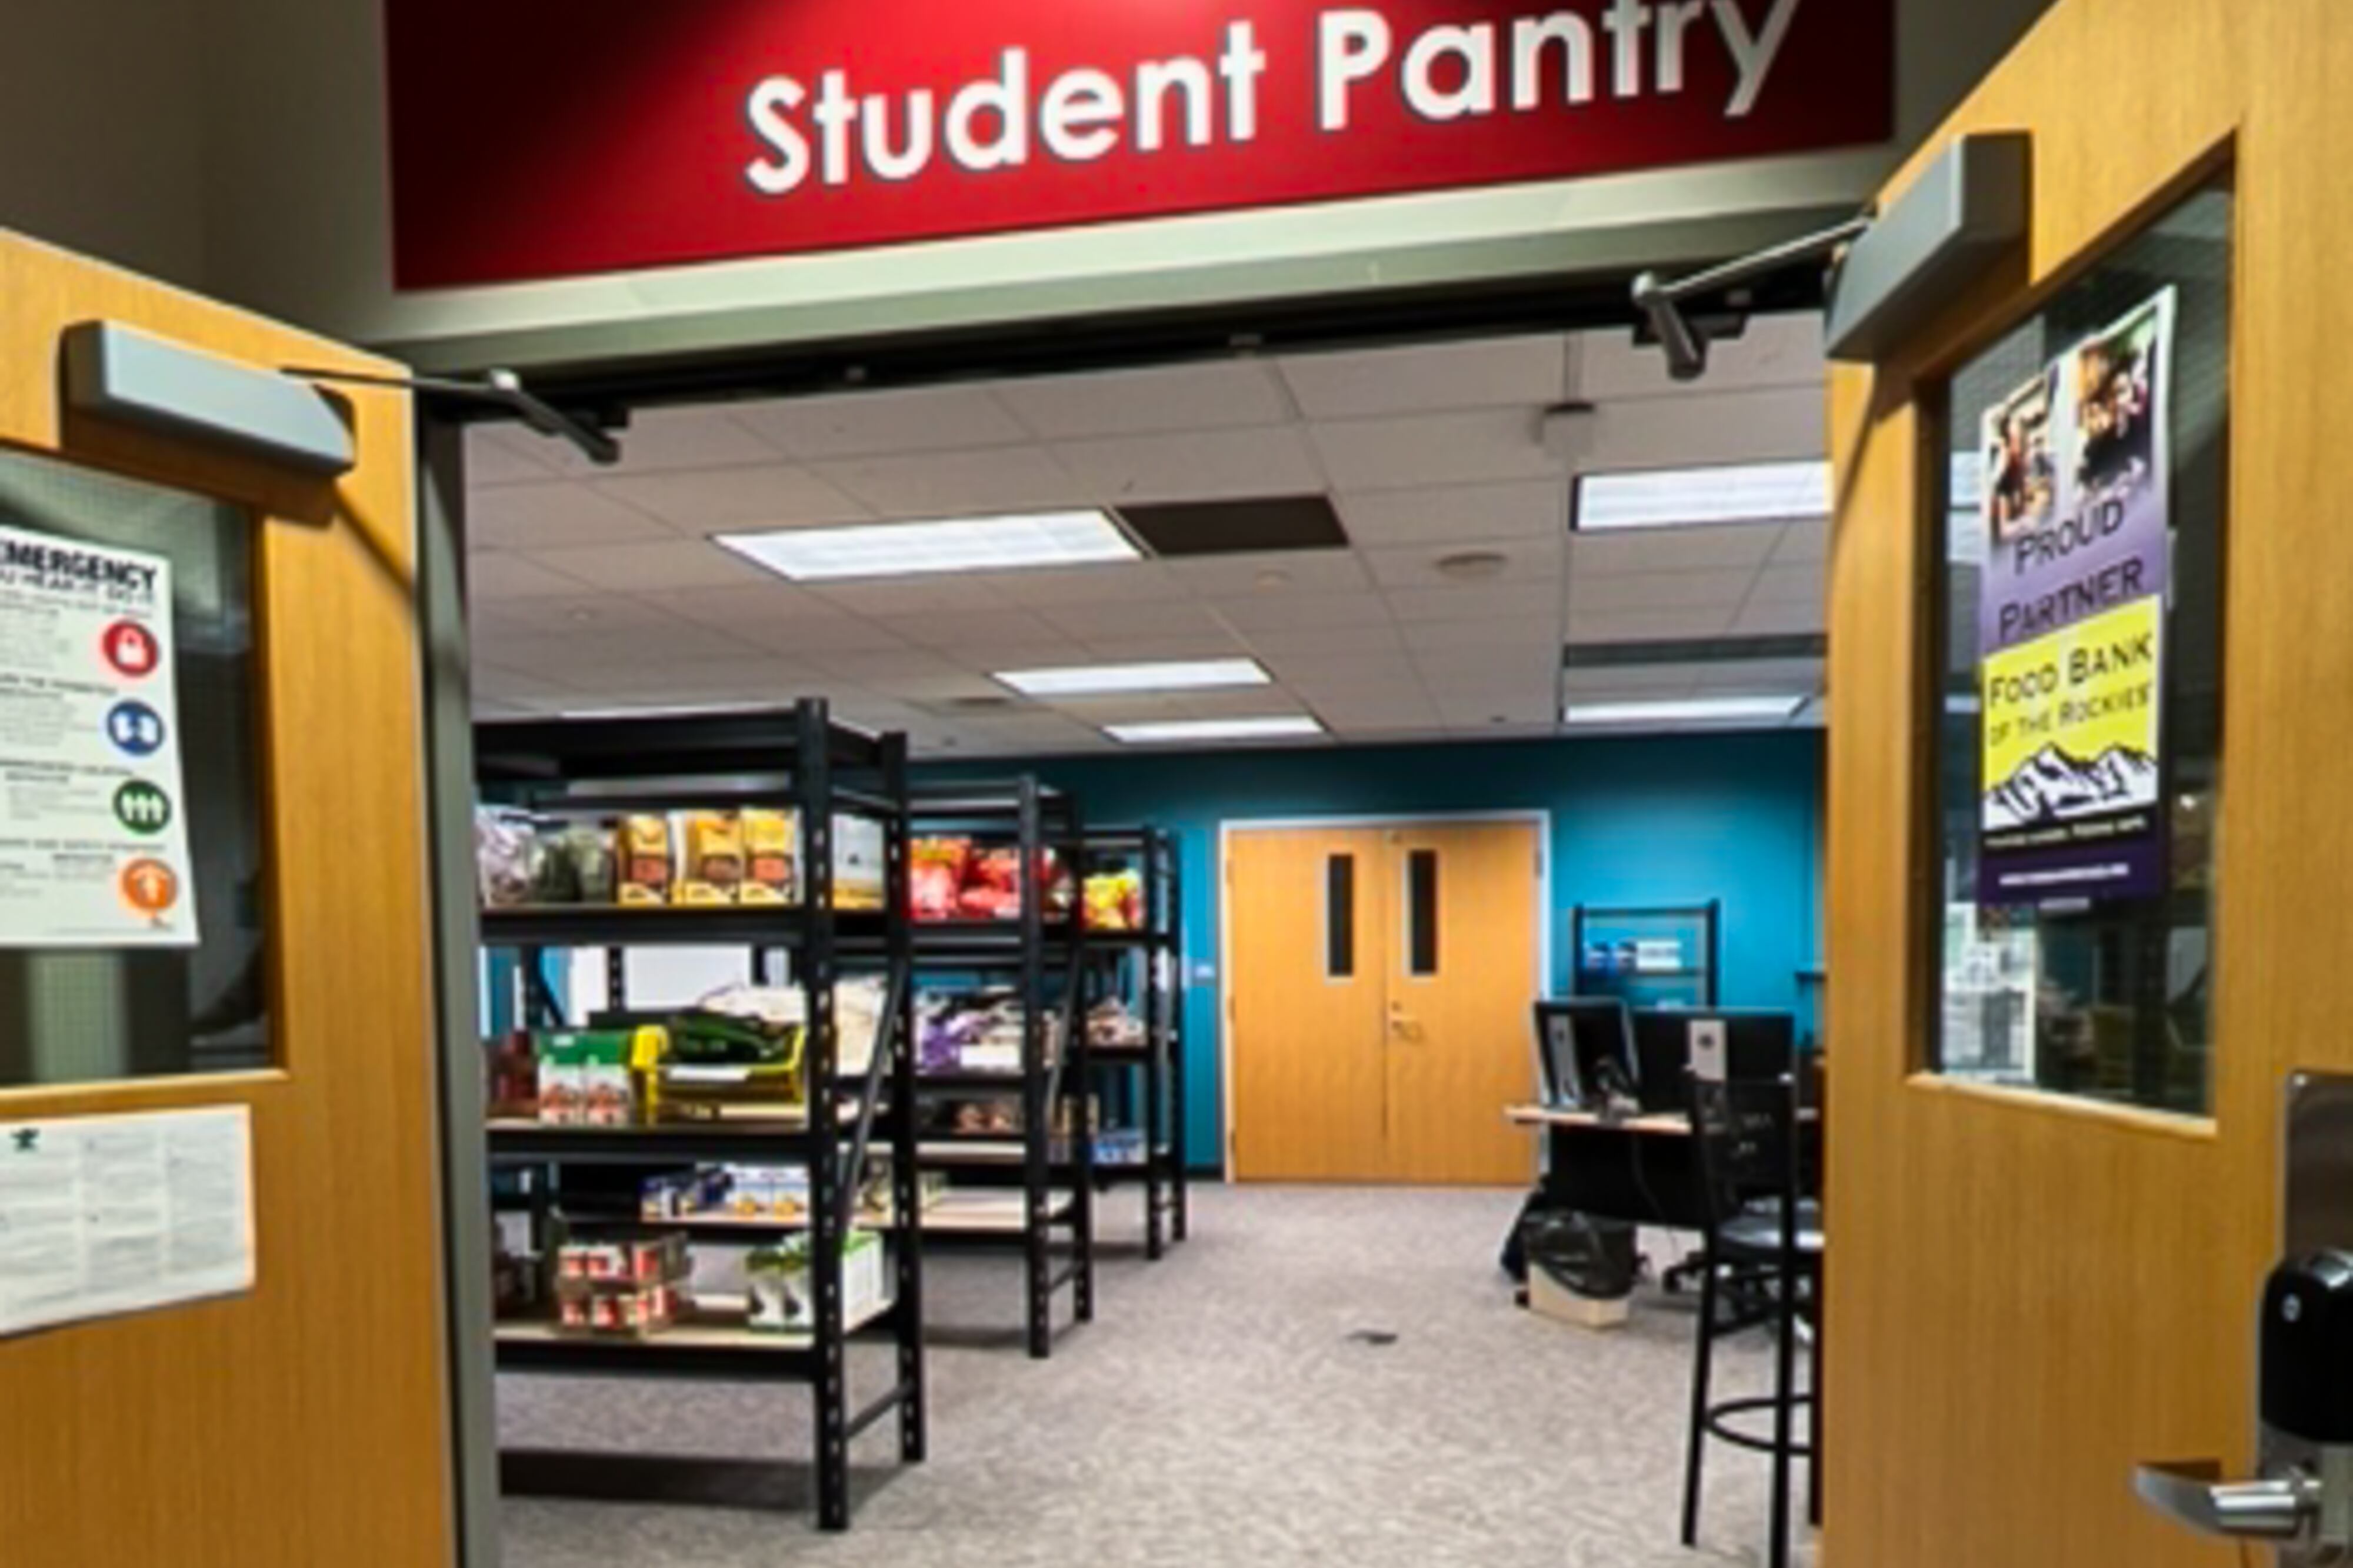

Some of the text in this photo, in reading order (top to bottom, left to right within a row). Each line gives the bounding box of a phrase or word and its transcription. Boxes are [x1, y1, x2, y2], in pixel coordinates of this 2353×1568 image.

[745, 0, 1799, 195] Student Pantry
[2014, 498, 2125, 576] PROUD
[1999, 556, 2144, 640] PARTNER
[1989, 631, 2152, 709] FOOD BANK
[2016, 708, 2051, 735] THE
